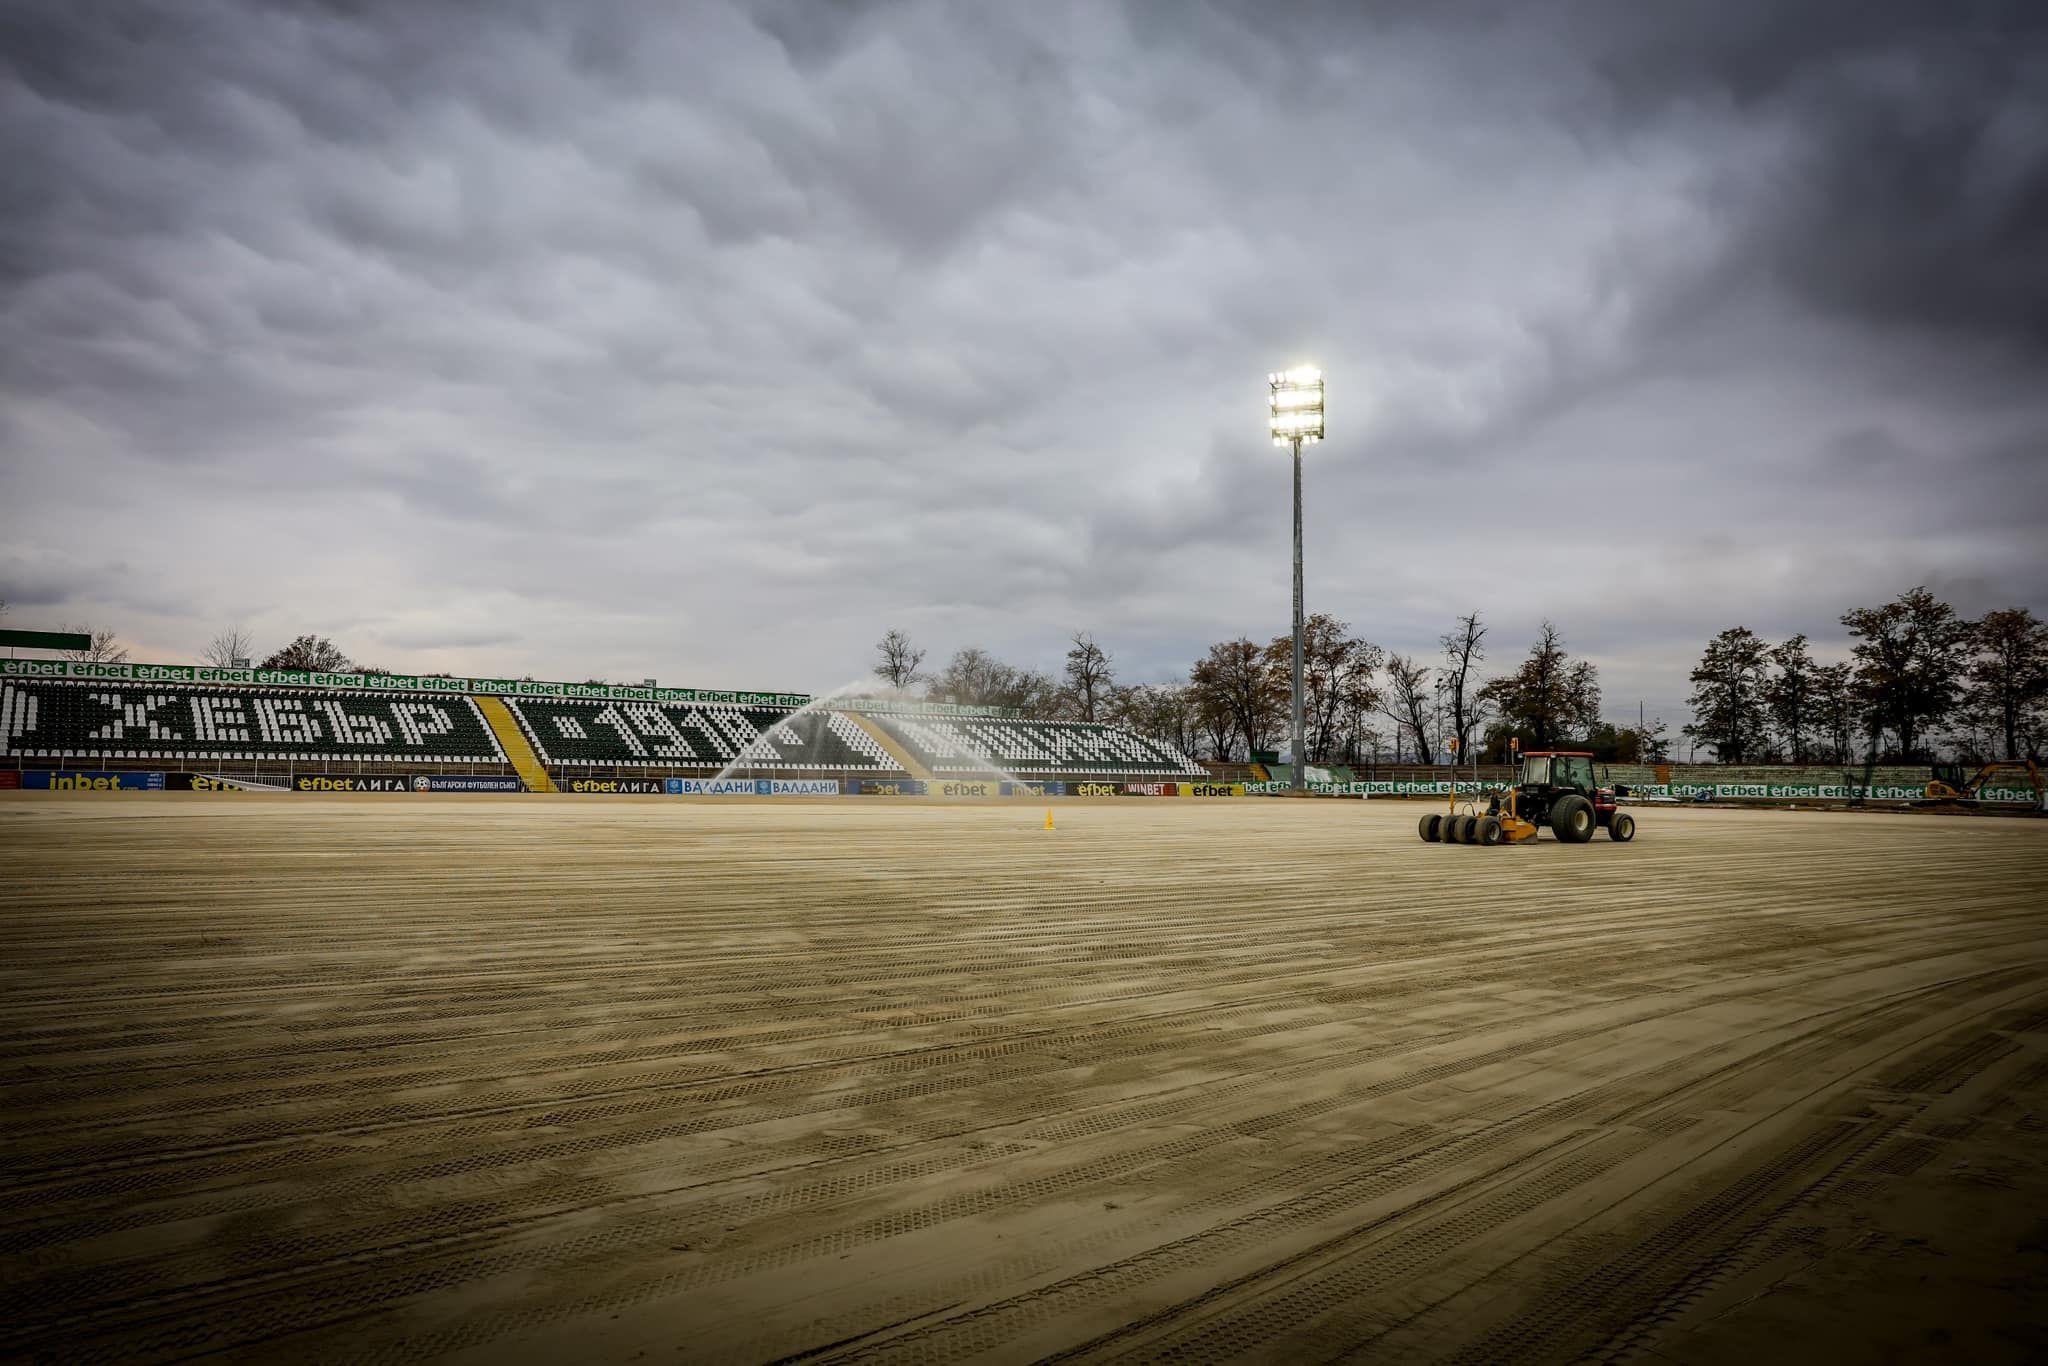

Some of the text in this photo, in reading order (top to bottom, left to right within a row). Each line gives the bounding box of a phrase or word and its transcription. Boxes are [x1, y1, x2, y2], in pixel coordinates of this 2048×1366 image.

[3, 661, 64, 675] efbet
[72, 663, 129, 677] efbet
[137, 666, 191, 680] efbet
[199, 669, 250, 682] efbet
[258, 670, 307, 684] efbet
[314, 673, 361, 686] efbet
[369, 676, 415, 689] efbet
[422, 679, 465, 690] efbet
[473, 680, 514, 692] efbet
[520, 683, 561, 694] efbet
[567, 685, 608, 696] efbet
[612, 688, 651, 699] efbet
[656, 689, 694, 701] efbet
[699, 691, 734, 703] efbet
[740, 693, 775, 704] efbet
[49, 772, 121, 791] inbet
[298, 777, 405, 791] efbet ЛИГА
[431, 780, 516, 790] БЪЛГАРСКИ ФУТБОЛЕН СЪЮЗ
[572, 780, 659, 793] efbet ЛИГА
[1354, 782, 1391, 793] efbet
[773, 782, 836, 794] ВАЛДАНИ
[944, 784, 987, 796] efbet
[1078, 784, 1115, 796] efbet
[1128, 783, 1165, 795] WINBET
[1192, 785, 1233, 796] efbet
[1311, 783, 1348, 793] efbet
[1398, 783, 1435, 794] efbet
[1722, 785, 1764, 797] efbet
[1771, 785, 1816, 797] efbet
[1877, 786, 1922, 798] efbet
[1984, 788, 2034, 801] efbet
